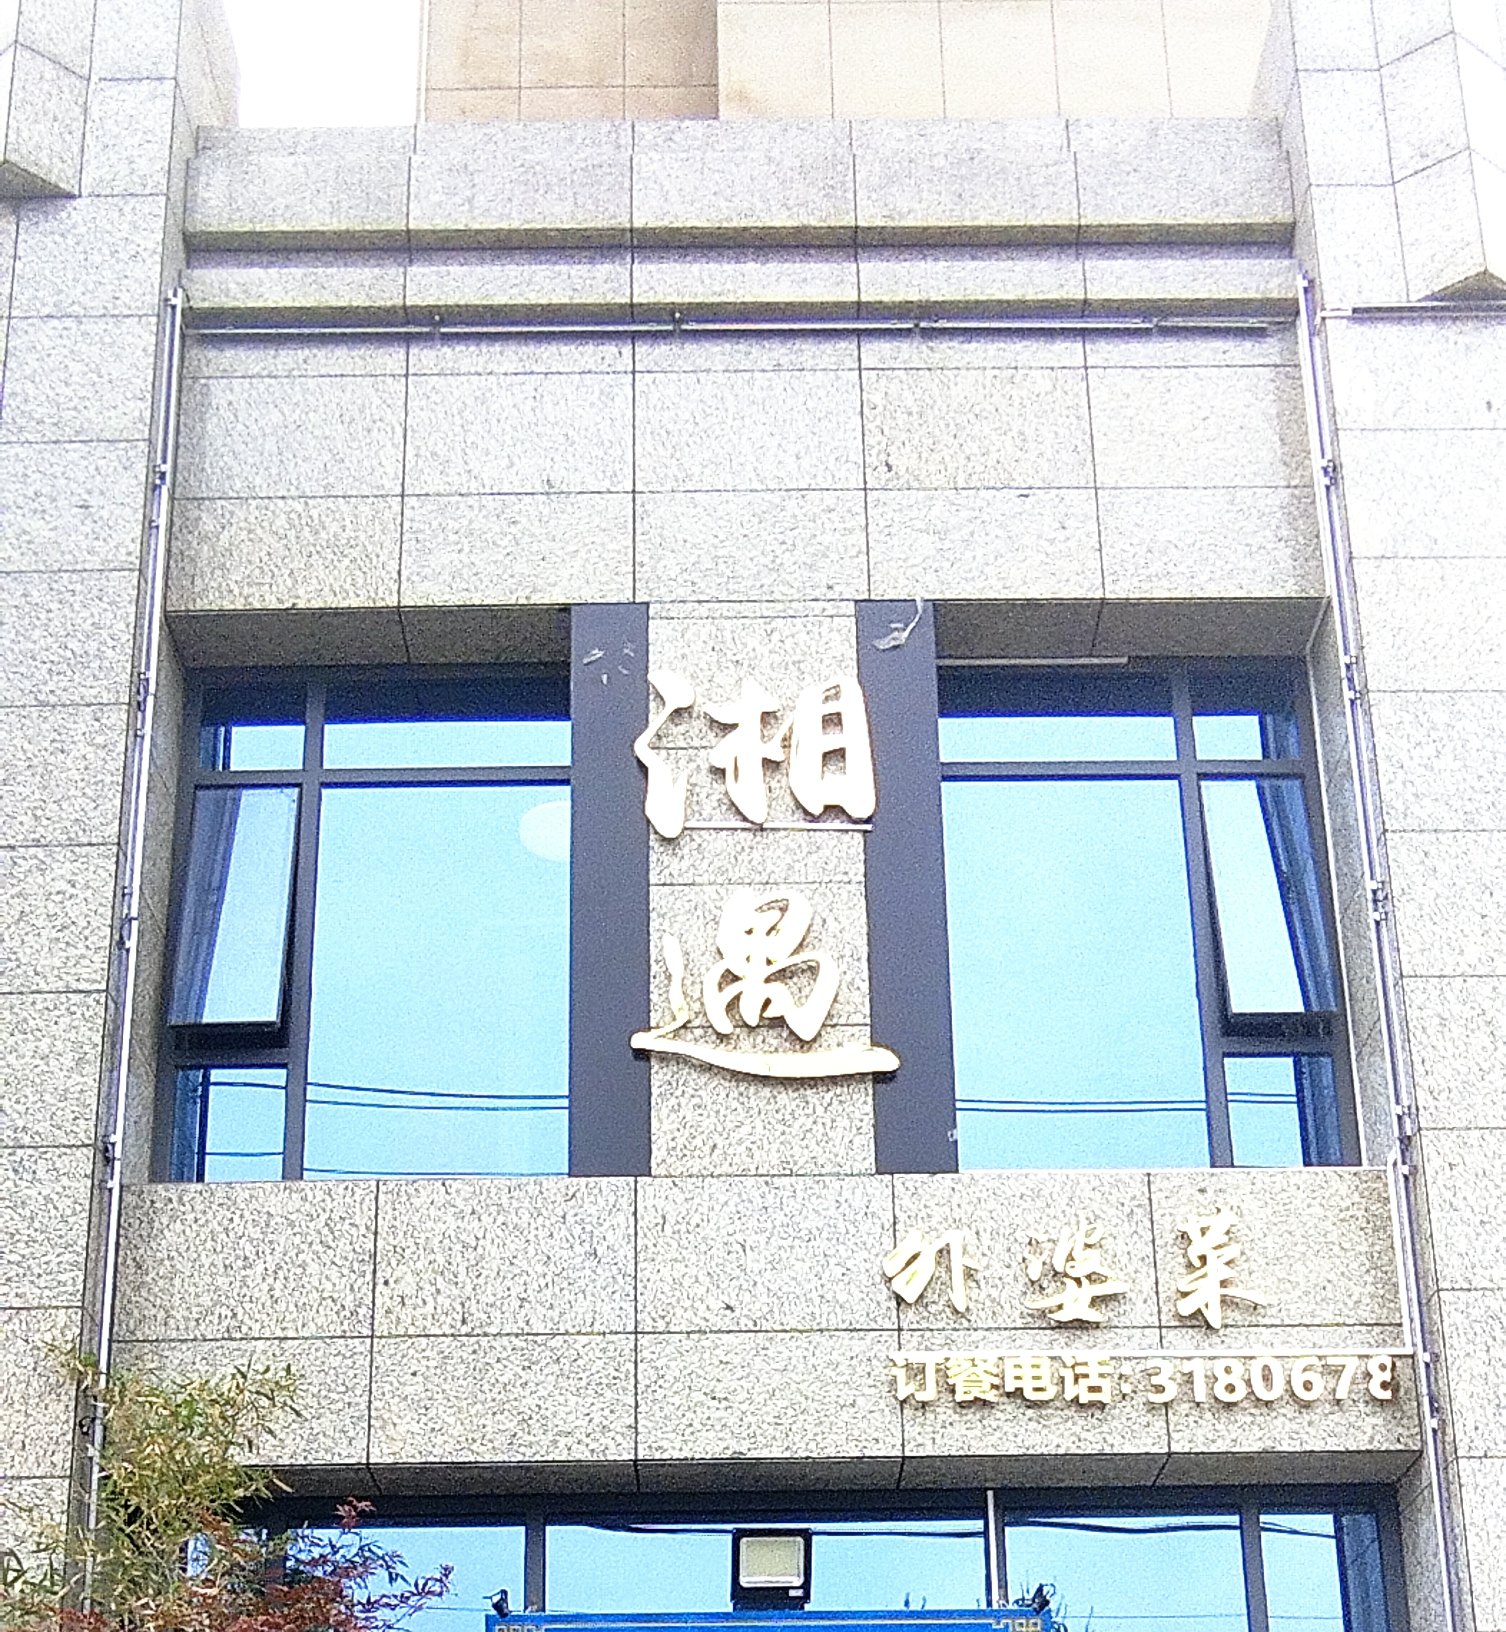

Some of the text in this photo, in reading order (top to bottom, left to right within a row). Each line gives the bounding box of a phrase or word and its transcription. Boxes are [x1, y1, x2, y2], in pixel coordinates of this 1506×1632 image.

[630, 671, 900, 1077] 湘遇
[883, 1208, 1267, 1329] 外婆菜
